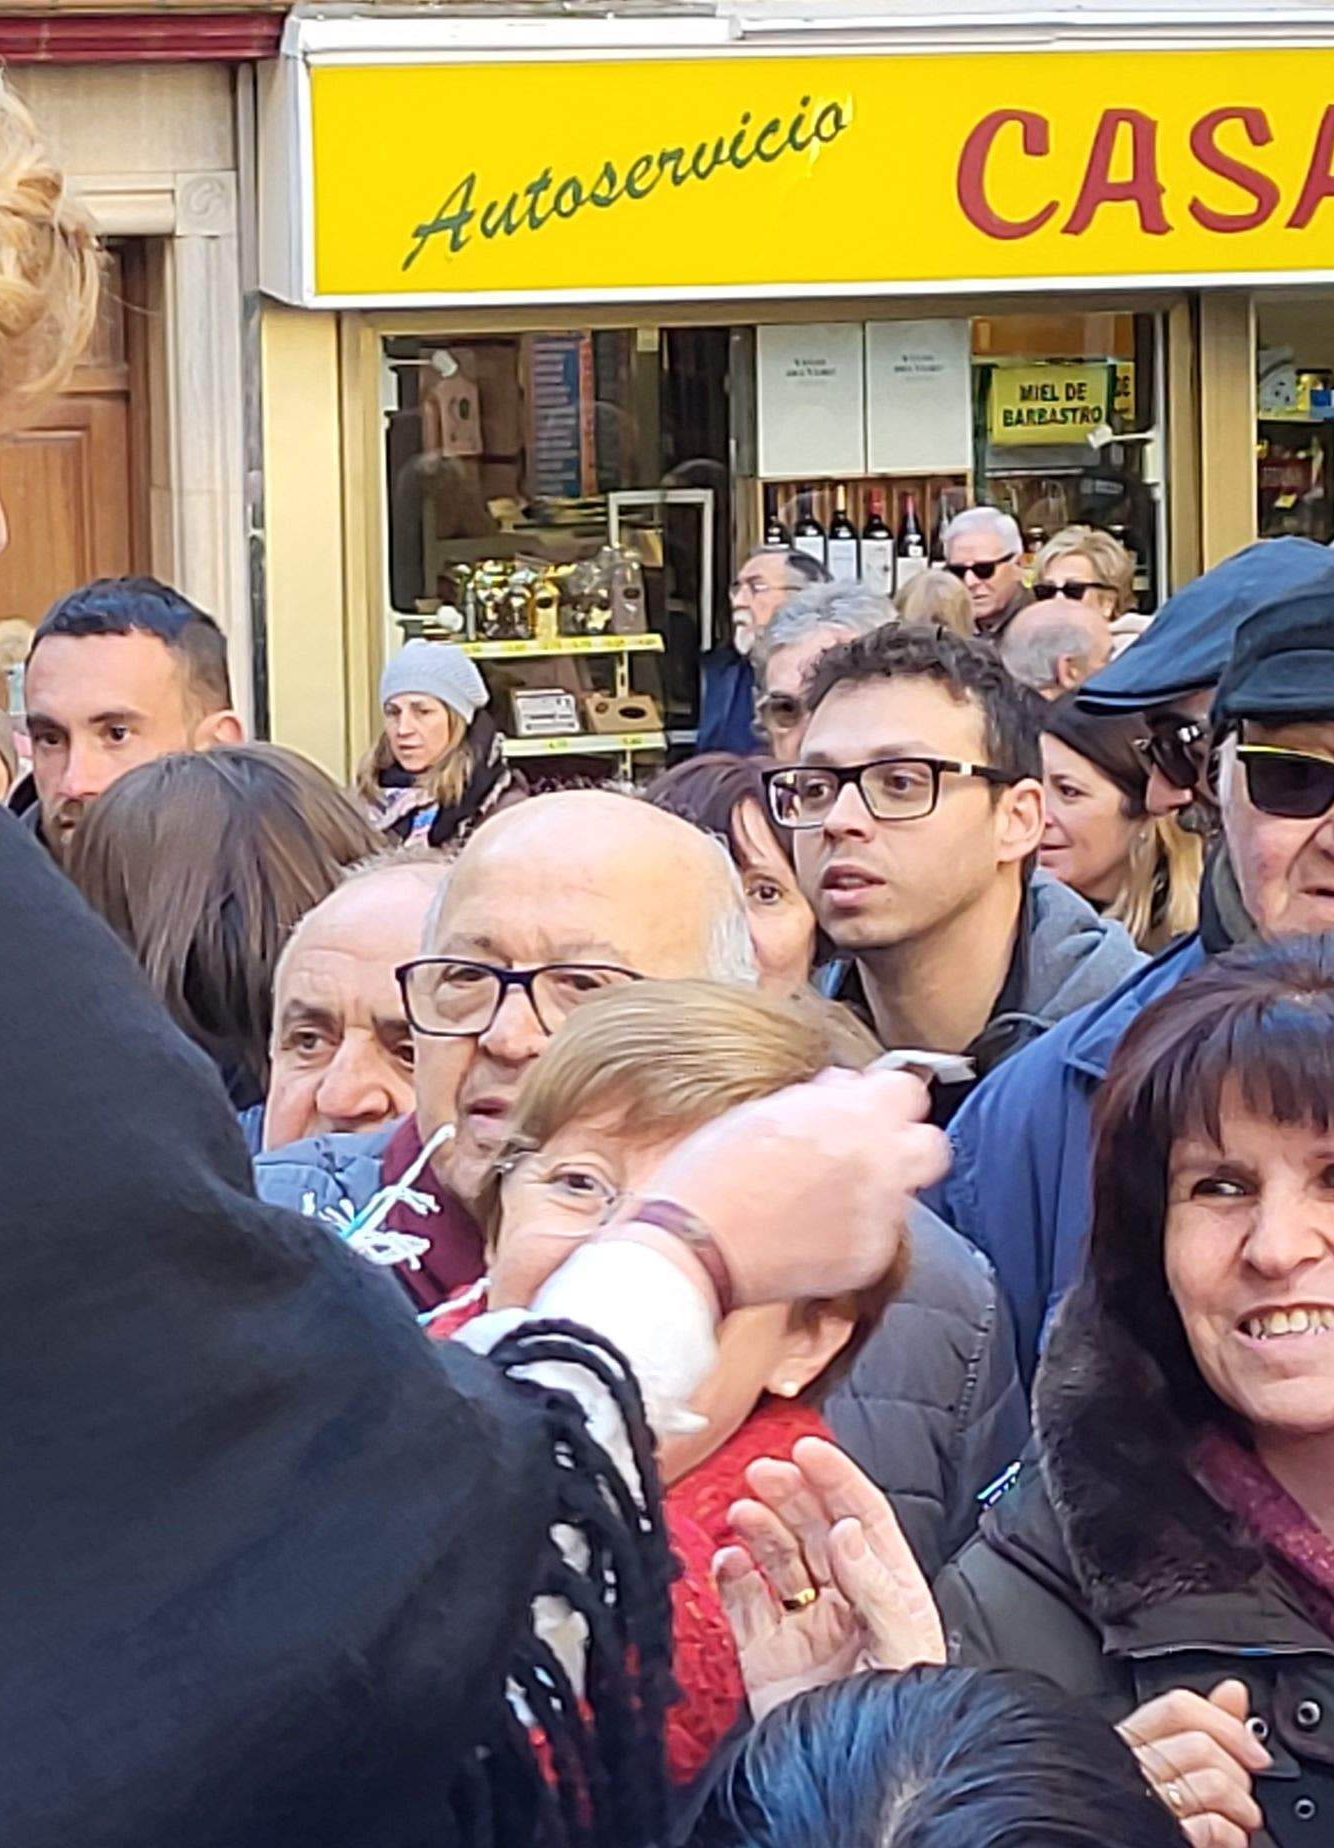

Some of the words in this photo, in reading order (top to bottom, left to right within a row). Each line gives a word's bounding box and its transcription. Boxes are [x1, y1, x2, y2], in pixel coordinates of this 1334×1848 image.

[401, 93, 850, 271] Autoservicio
[1019, 382, 1059, 402] MIEL
[1065, 381, 1088, 402] DE
[1002, 404, 1104, 428] BARBASTRO
